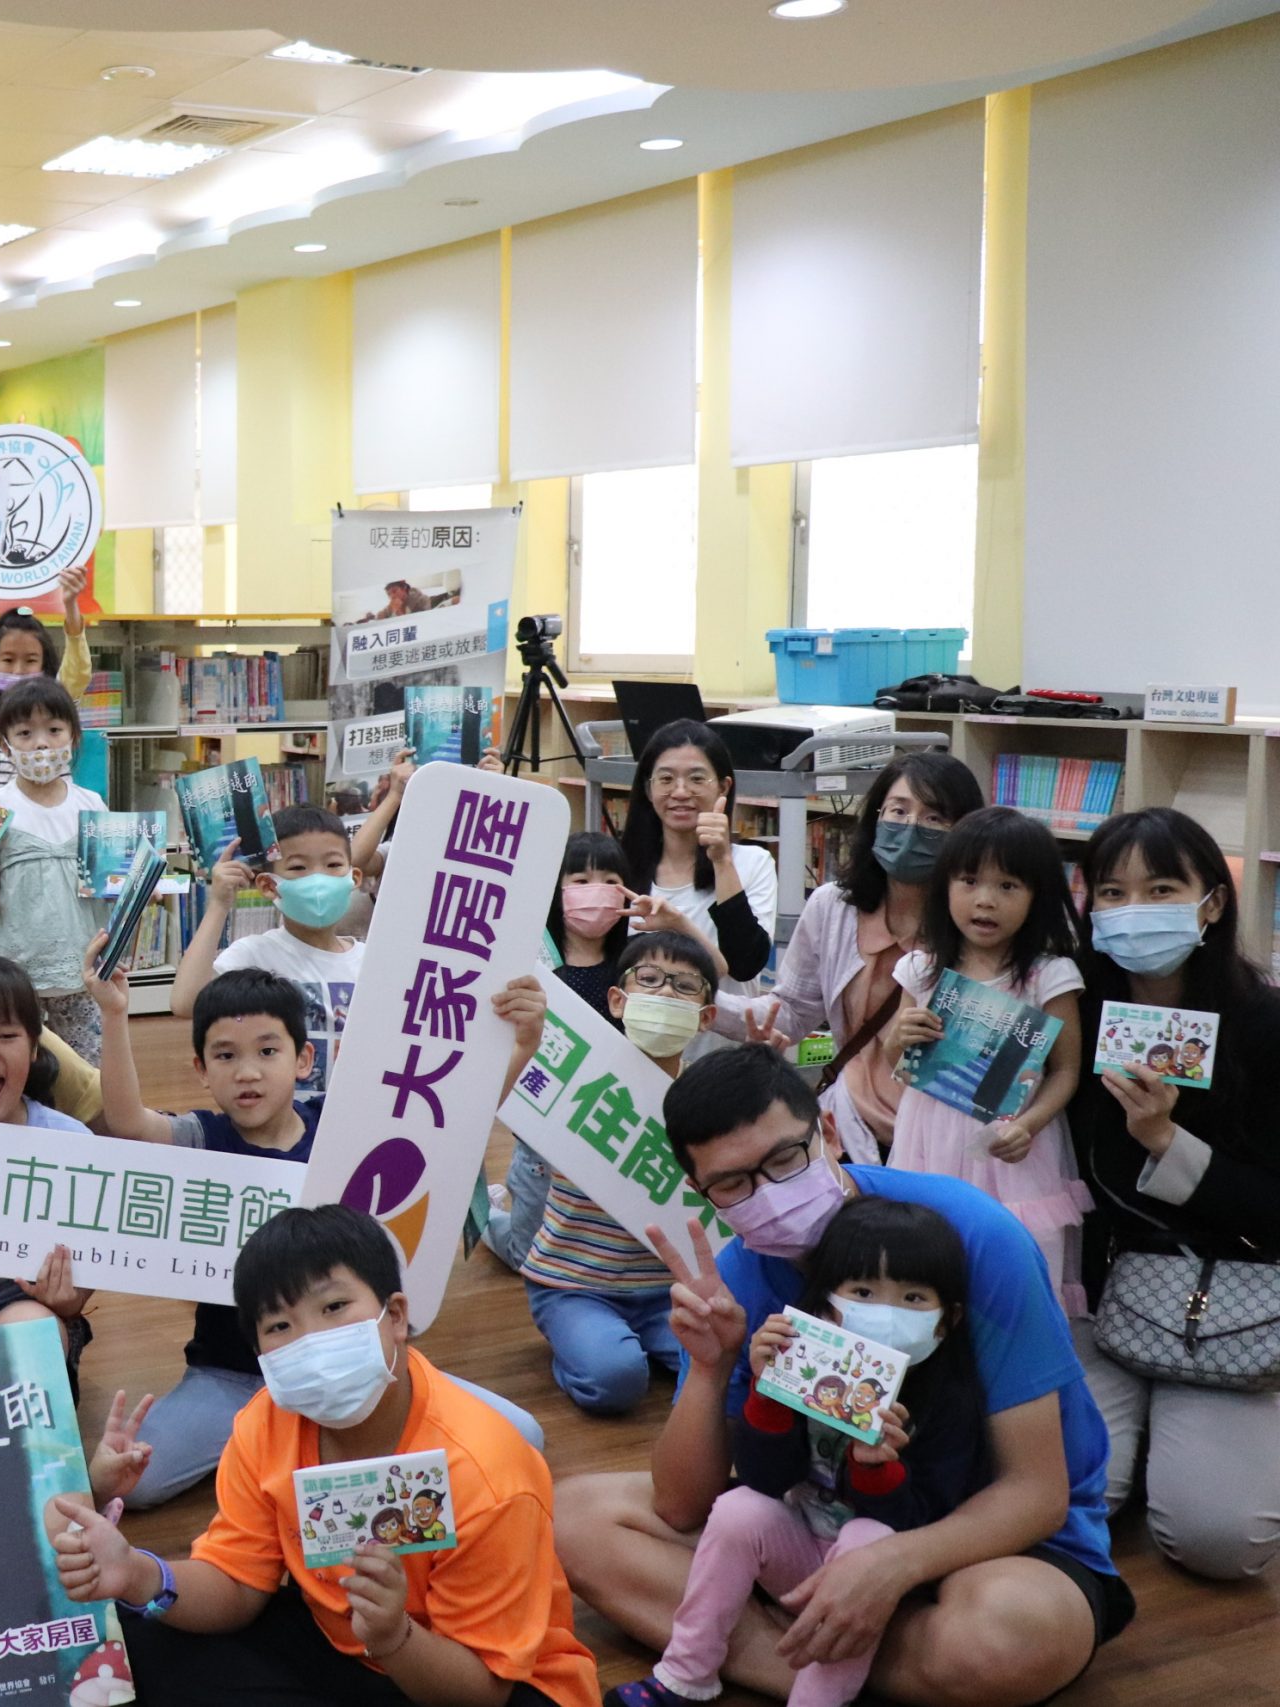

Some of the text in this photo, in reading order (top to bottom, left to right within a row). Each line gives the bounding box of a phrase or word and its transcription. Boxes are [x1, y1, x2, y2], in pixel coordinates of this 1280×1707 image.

[1, 521, 85, 584] WORLD TAIWAN
[352, 625, 418, 652] 融入同輩
[371, 633, 488, 672] 想要逃避或放鬆
[1151, 688, 1220, 704] 台灣文史專區
[1150, 708, 1177, 716] Taiwan
[382, 789, 530, 1129] 大家房屋
[56, 1243, 148, 1270] ublic
[39, 1674, 56, 1685] 發行
